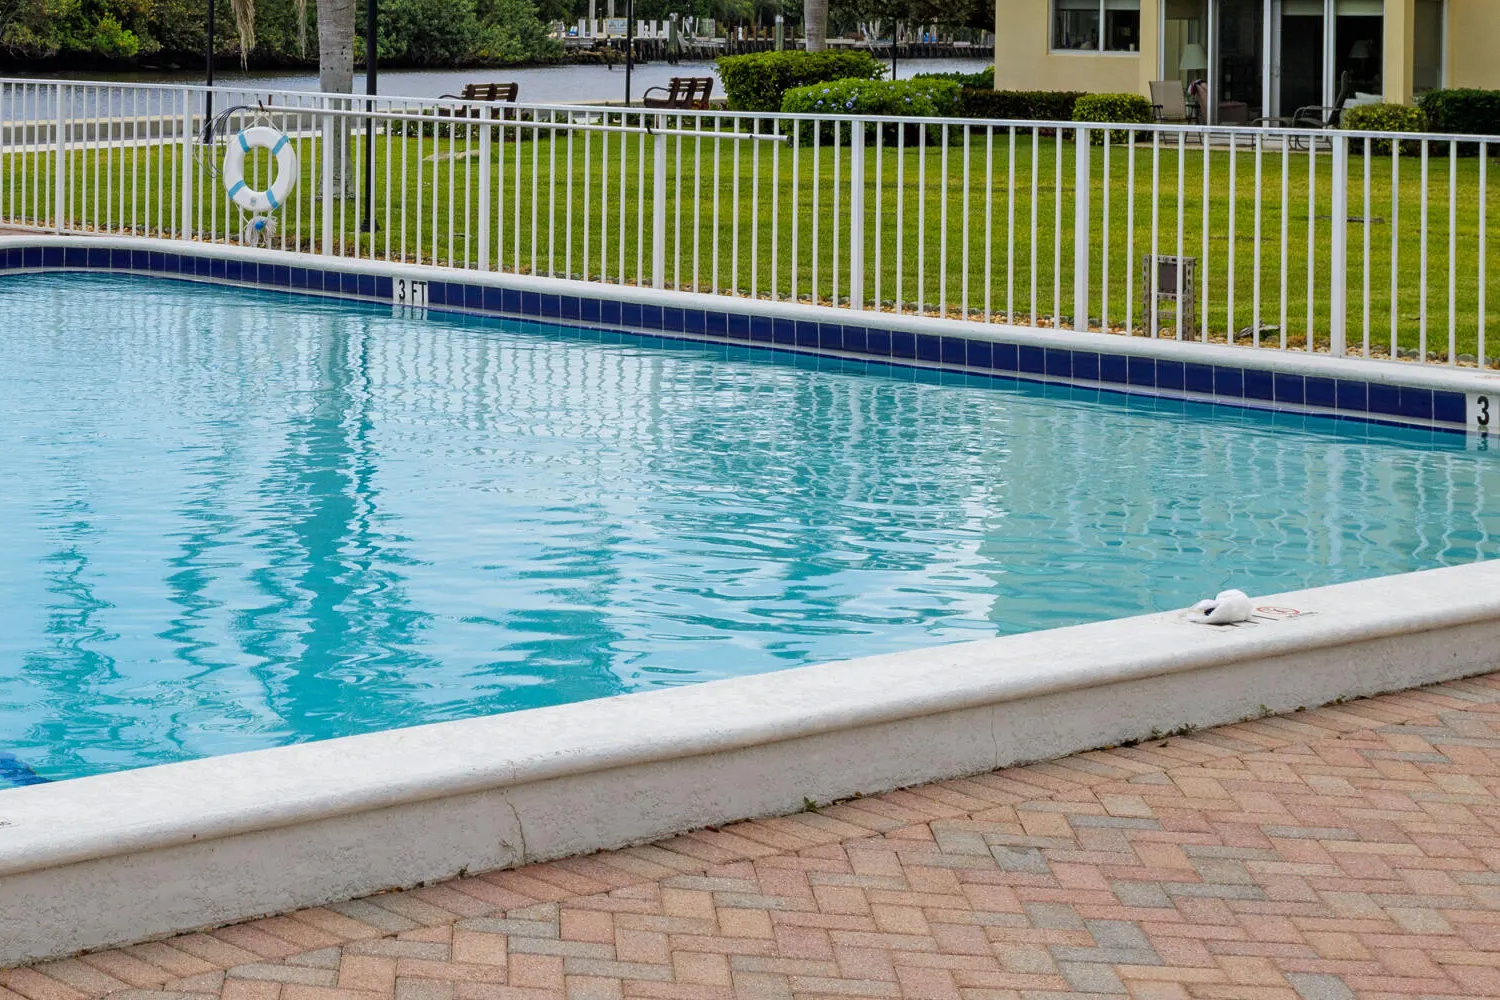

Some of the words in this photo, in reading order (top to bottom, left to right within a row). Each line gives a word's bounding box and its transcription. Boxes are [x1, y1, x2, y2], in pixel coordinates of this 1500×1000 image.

[399, 279, 406, 300] 3
[411, 281, 427, 303] FT
[1477, 395, 1489, 426] 3
